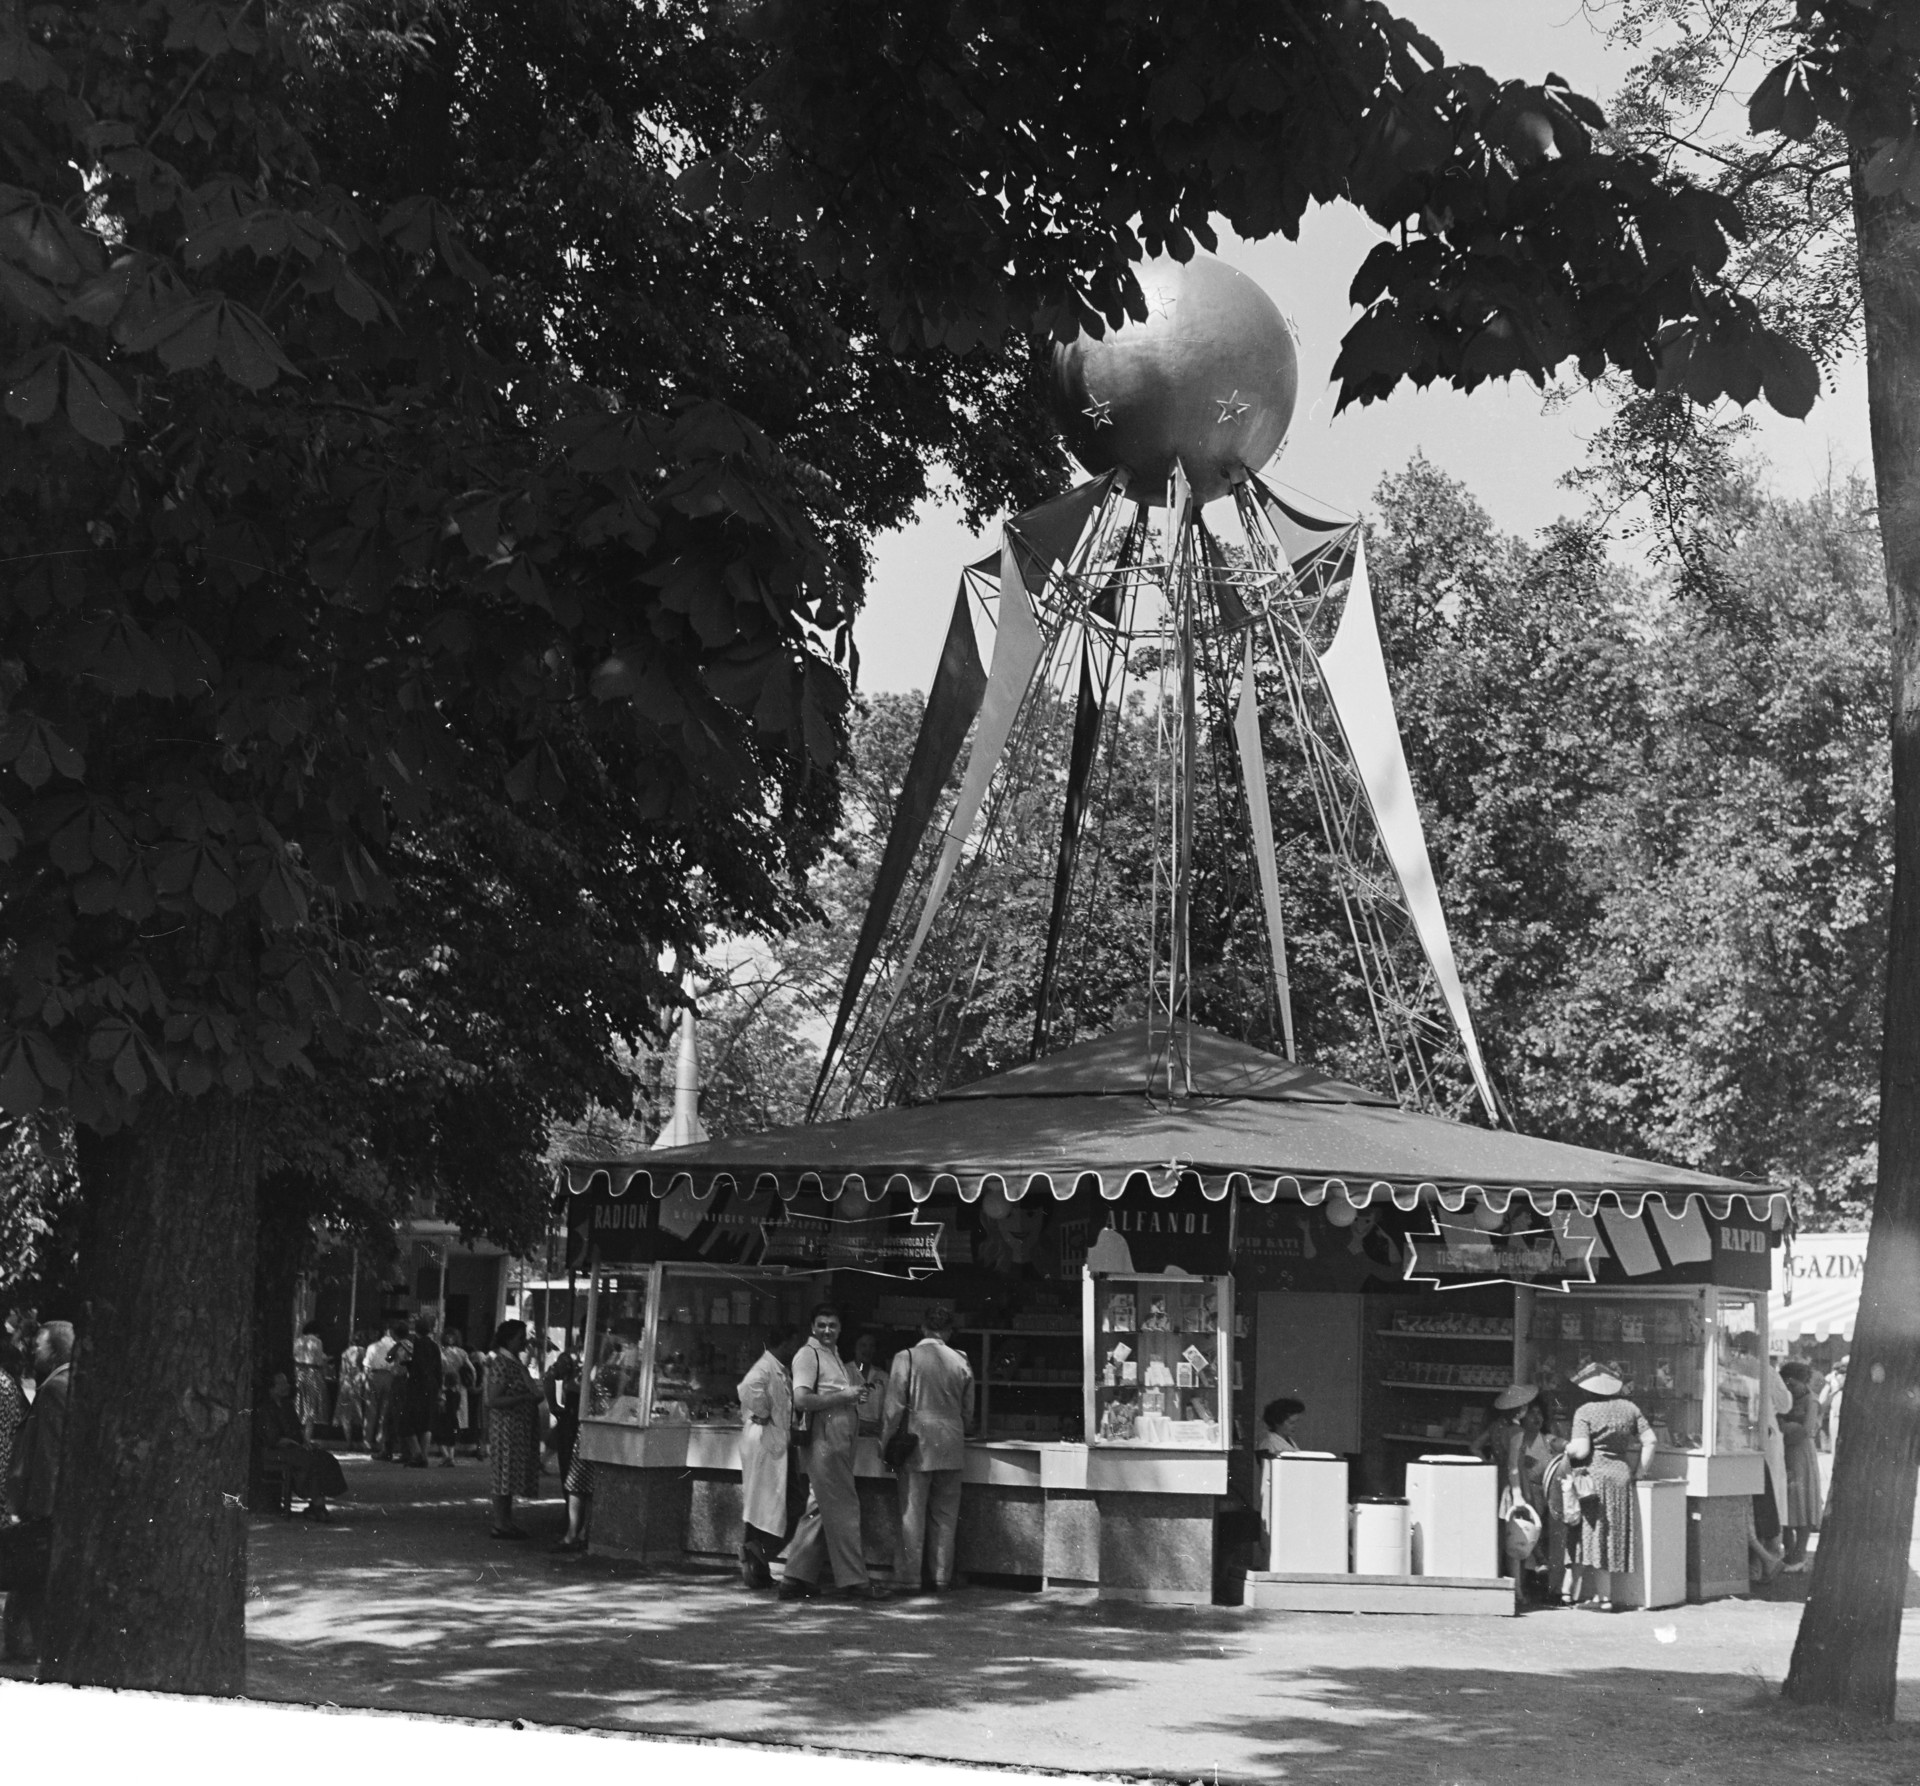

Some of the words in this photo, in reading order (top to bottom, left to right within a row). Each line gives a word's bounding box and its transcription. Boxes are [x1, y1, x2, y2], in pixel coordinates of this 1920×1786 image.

[594, 1204, 649, 1229] RADION
[1106, 1210, 1212, 1234] ALFANOL
[1720, 1226, 1766, 1253] RAPID
